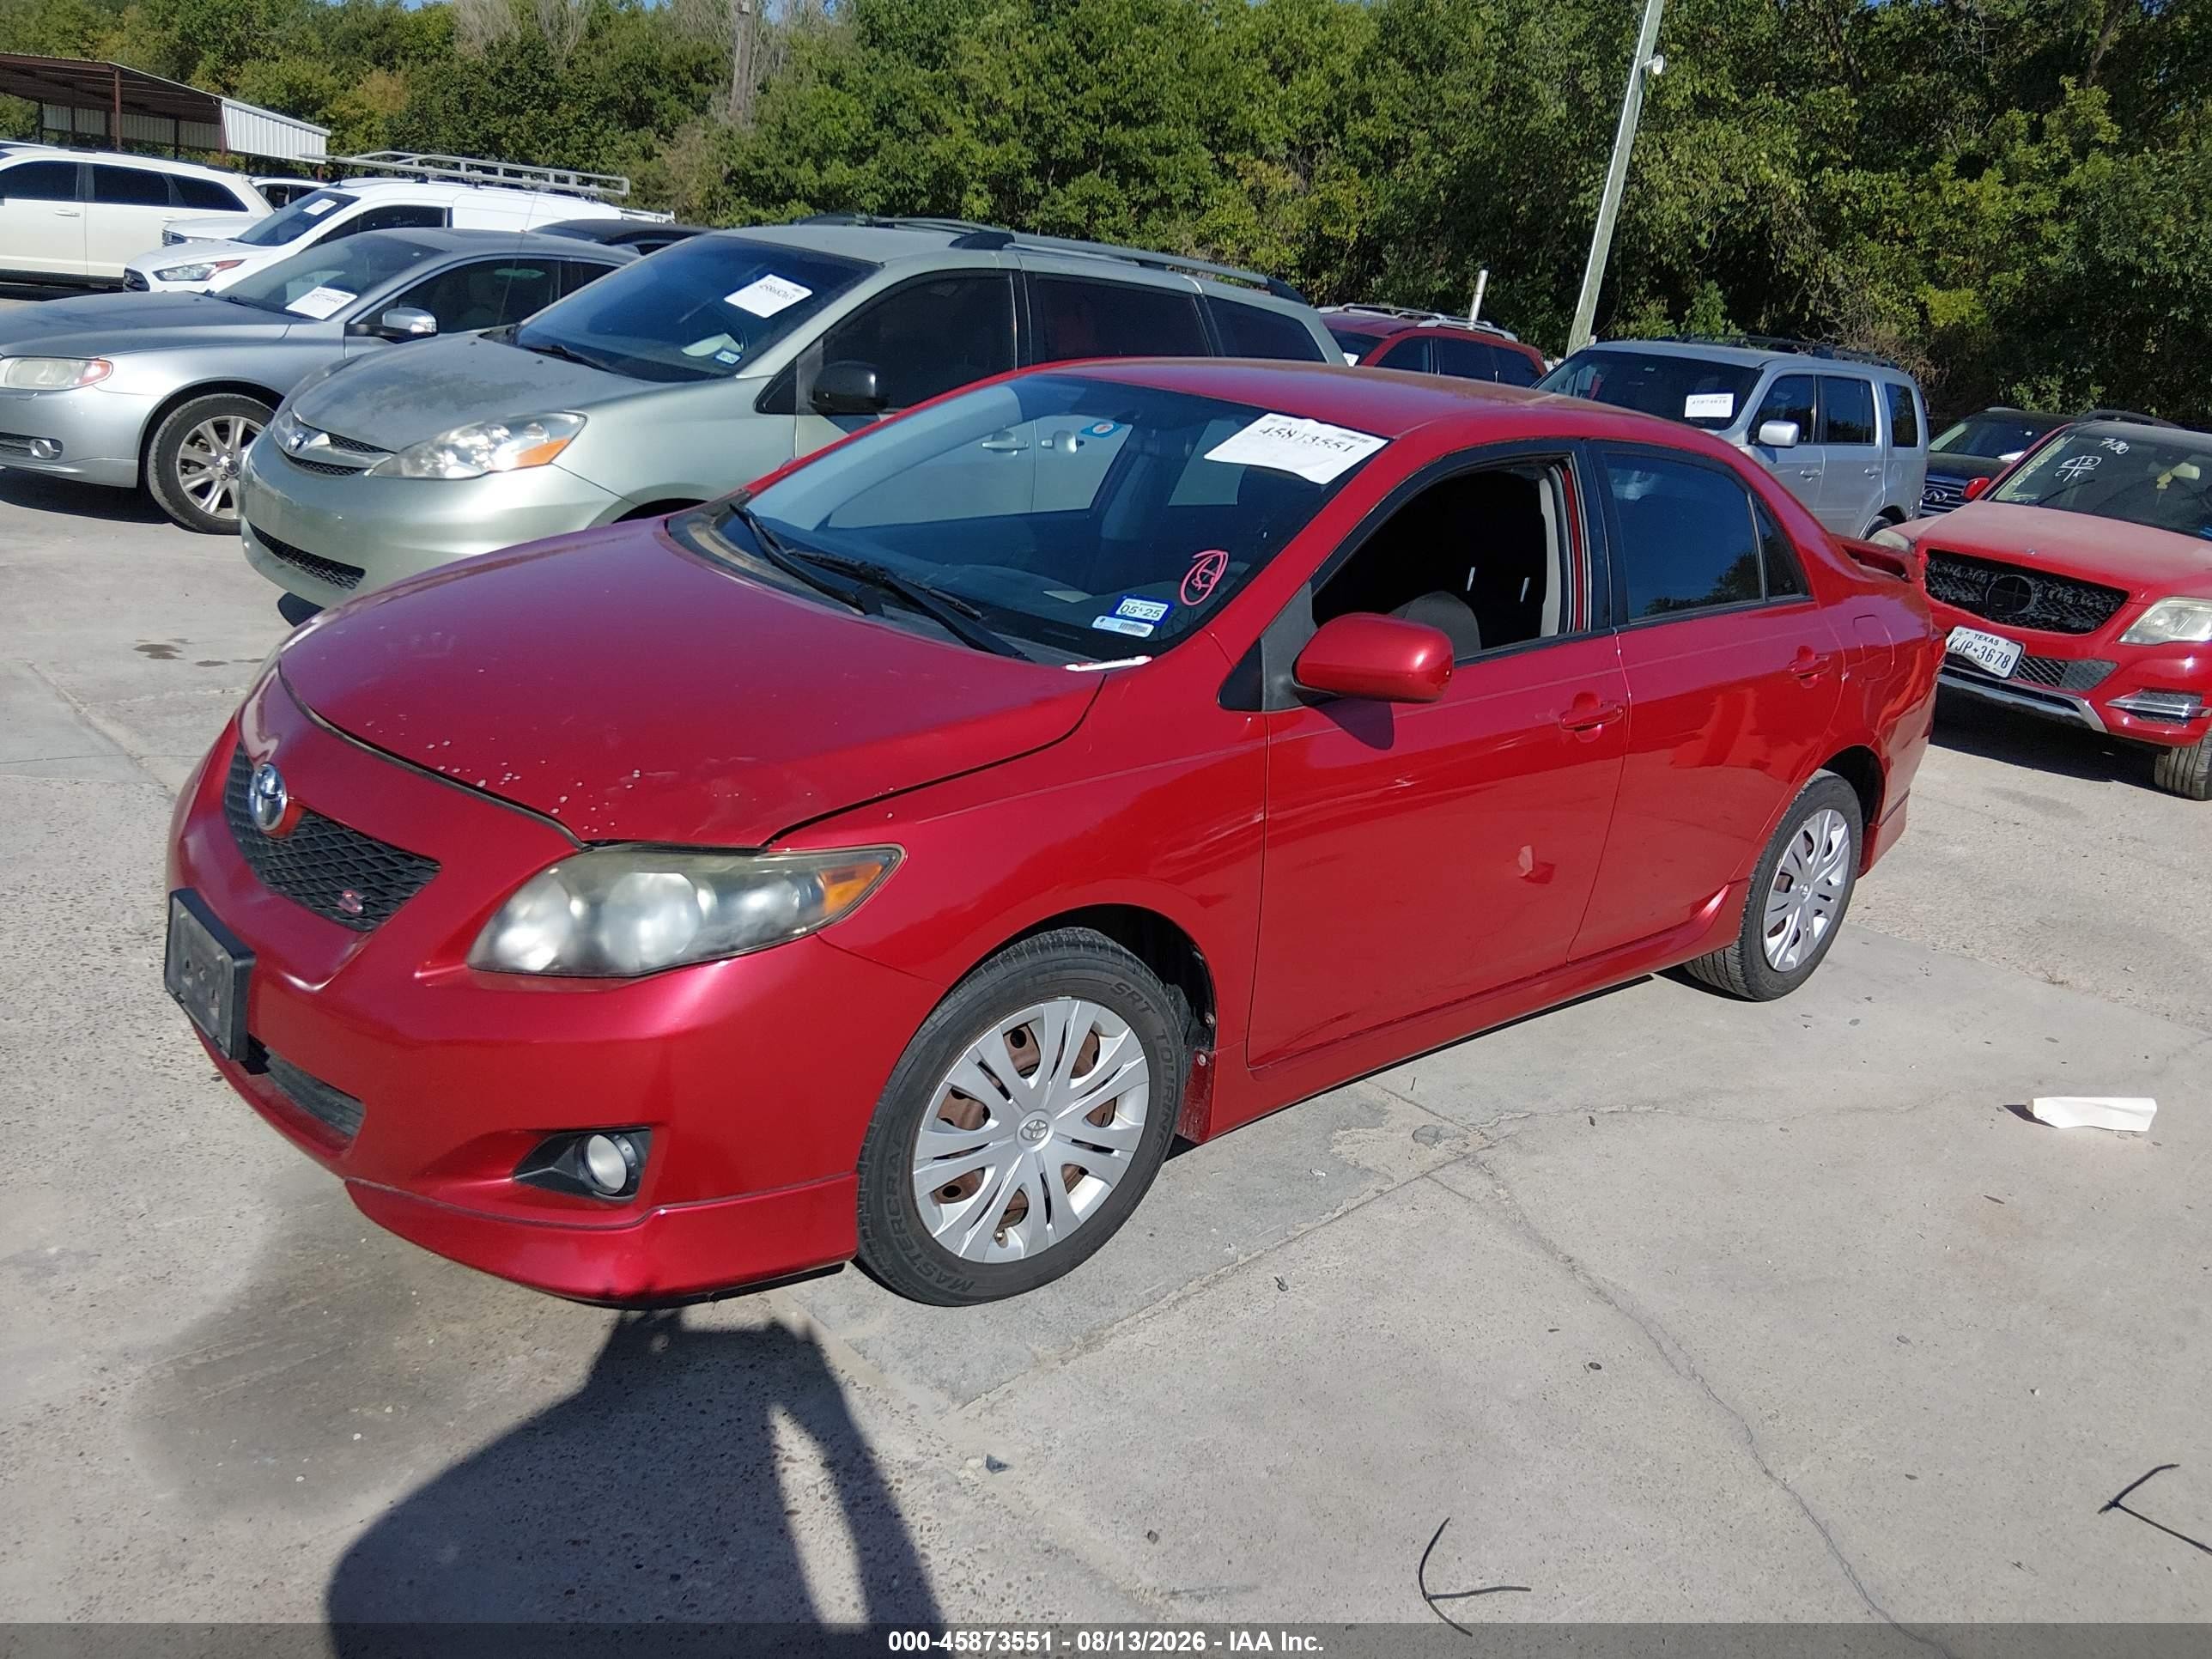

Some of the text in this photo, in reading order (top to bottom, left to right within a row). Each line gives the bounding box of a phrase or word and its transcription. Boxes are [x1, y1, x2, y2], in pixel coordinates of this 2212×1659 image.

[1120, 604, 1139, 615] 05
[1142, 608, 1163, 618] 25
[1973, 633, 2000, 647] TEXAS
[1109, 981, 1157, 1015] SRT
